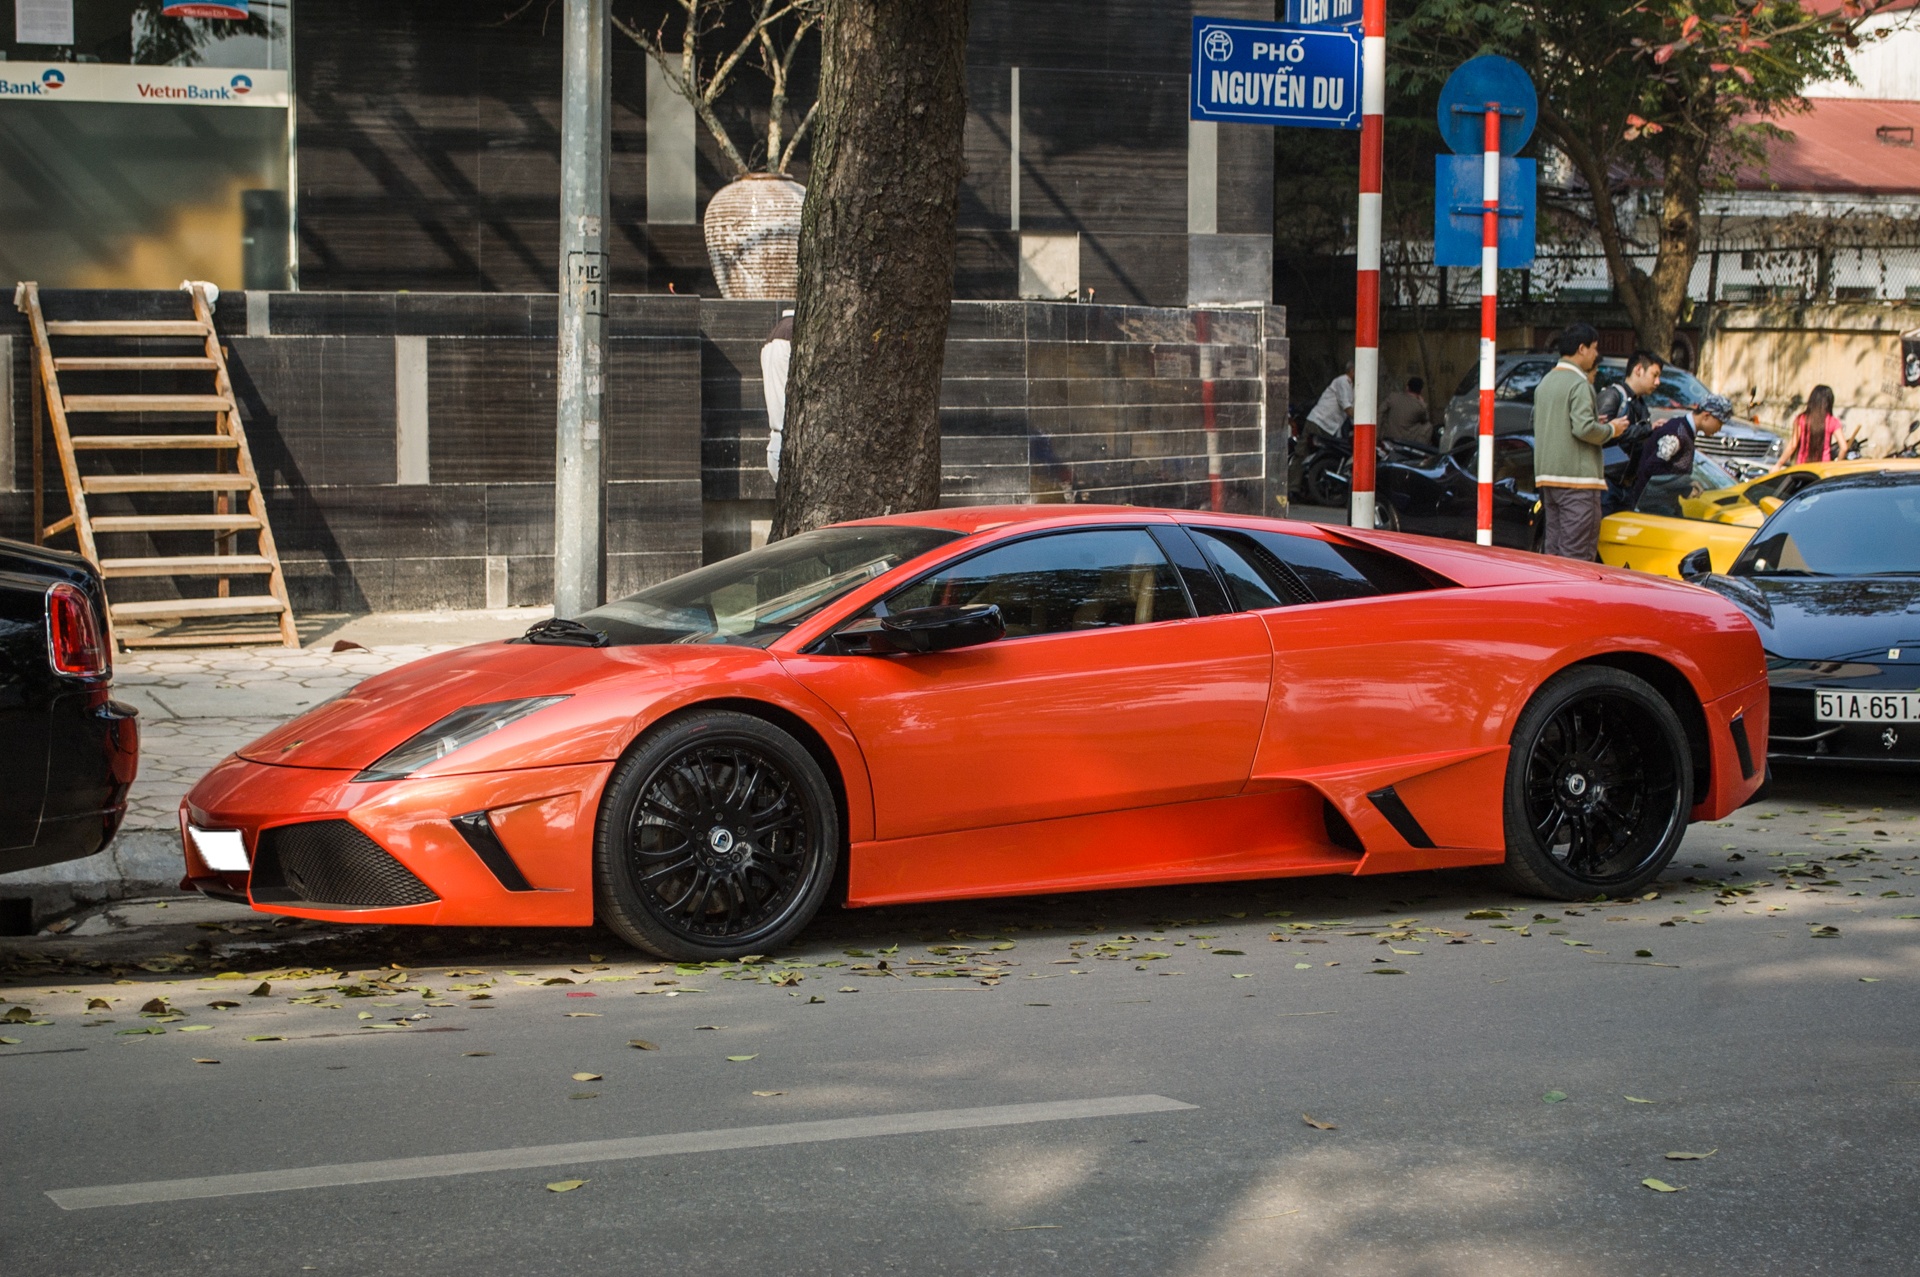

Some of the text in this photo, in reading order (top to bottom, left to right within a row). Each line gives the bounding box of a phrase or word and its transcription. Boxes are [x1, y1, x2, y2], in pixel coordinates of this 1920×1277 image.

[1252, 37, 1305, 63] PHỐ
[137, 83, 230, 100] VietinBank
[1211, 66, 1344, 111] NGUYỄN DU
